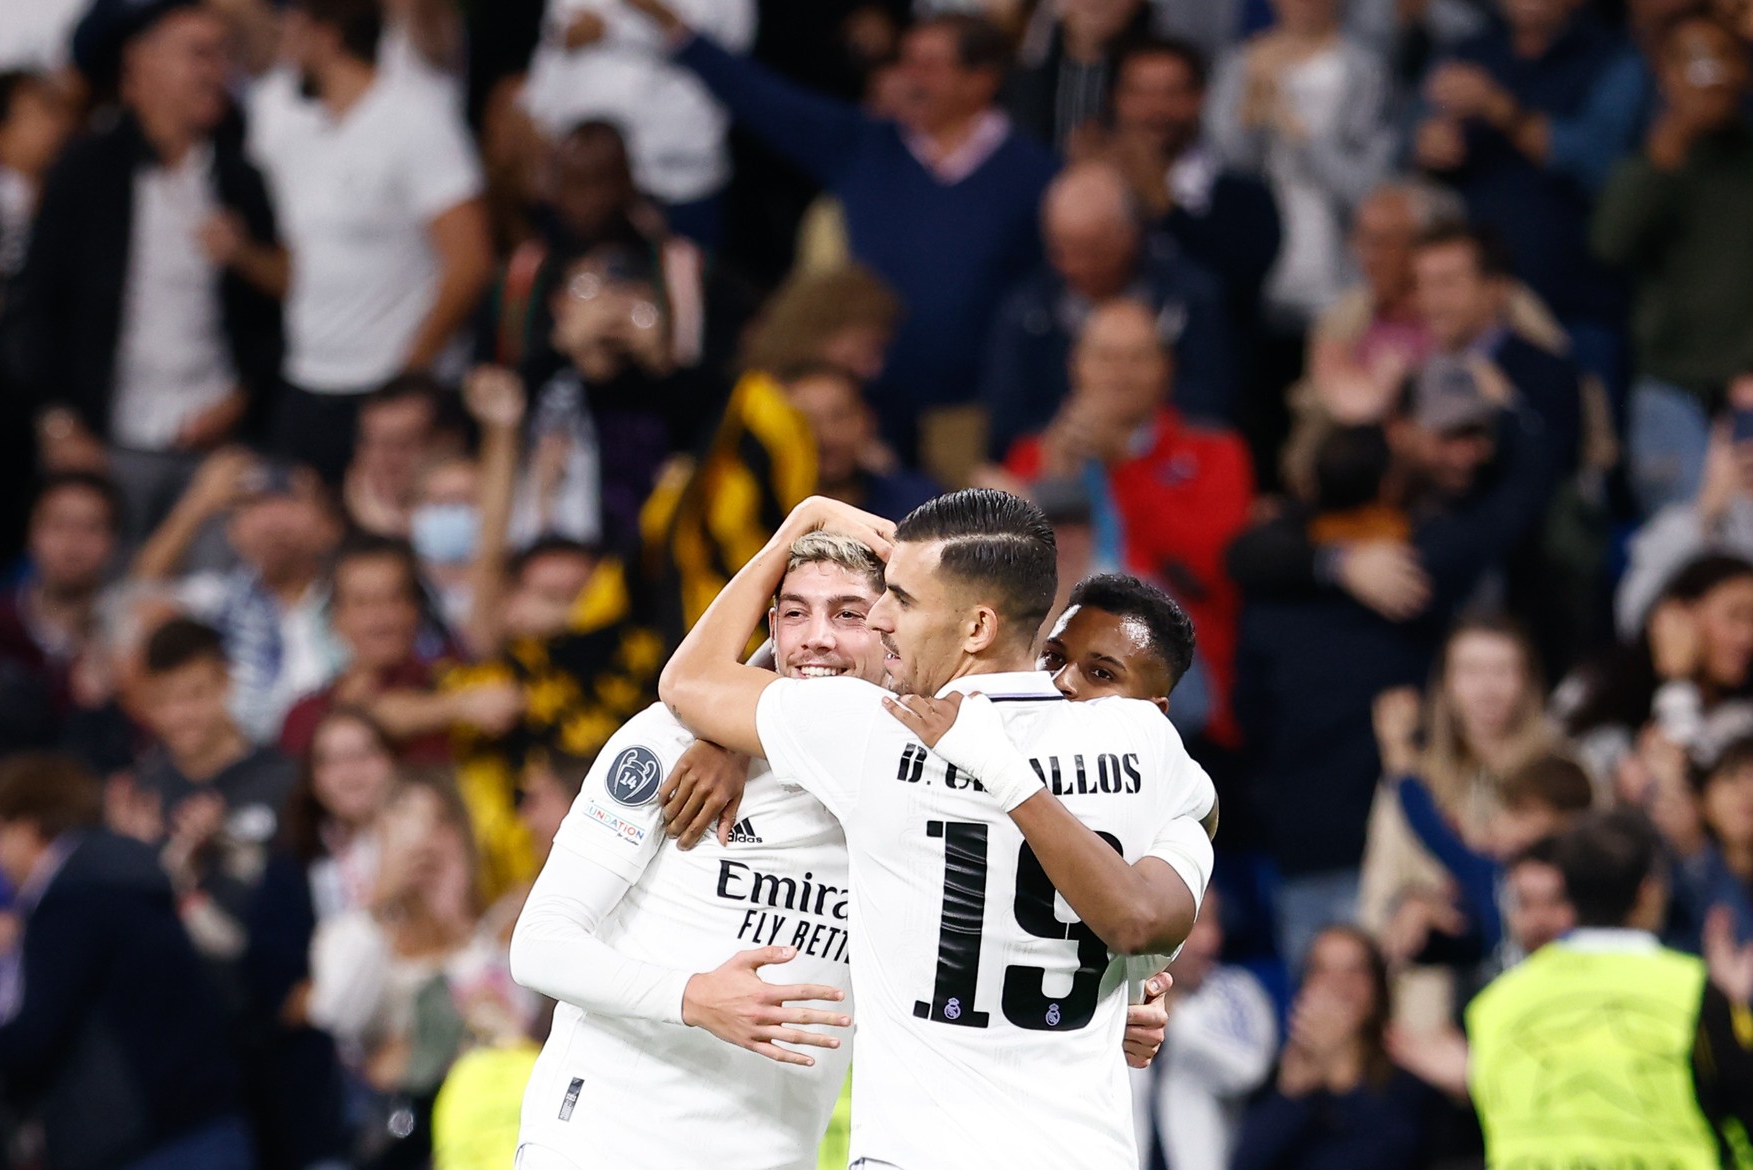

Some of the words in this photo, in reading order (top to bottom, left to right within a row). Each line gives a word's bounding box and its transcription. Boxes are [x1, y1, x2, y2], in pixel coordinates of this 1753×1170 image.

[620, 771, 638, 790] 14
[727, 832, 763, 844] didas
[716, 858, 849, 921] Emira
[737, 909, 787, 947] FLY
[913, 820, 1124, 1032] 19
